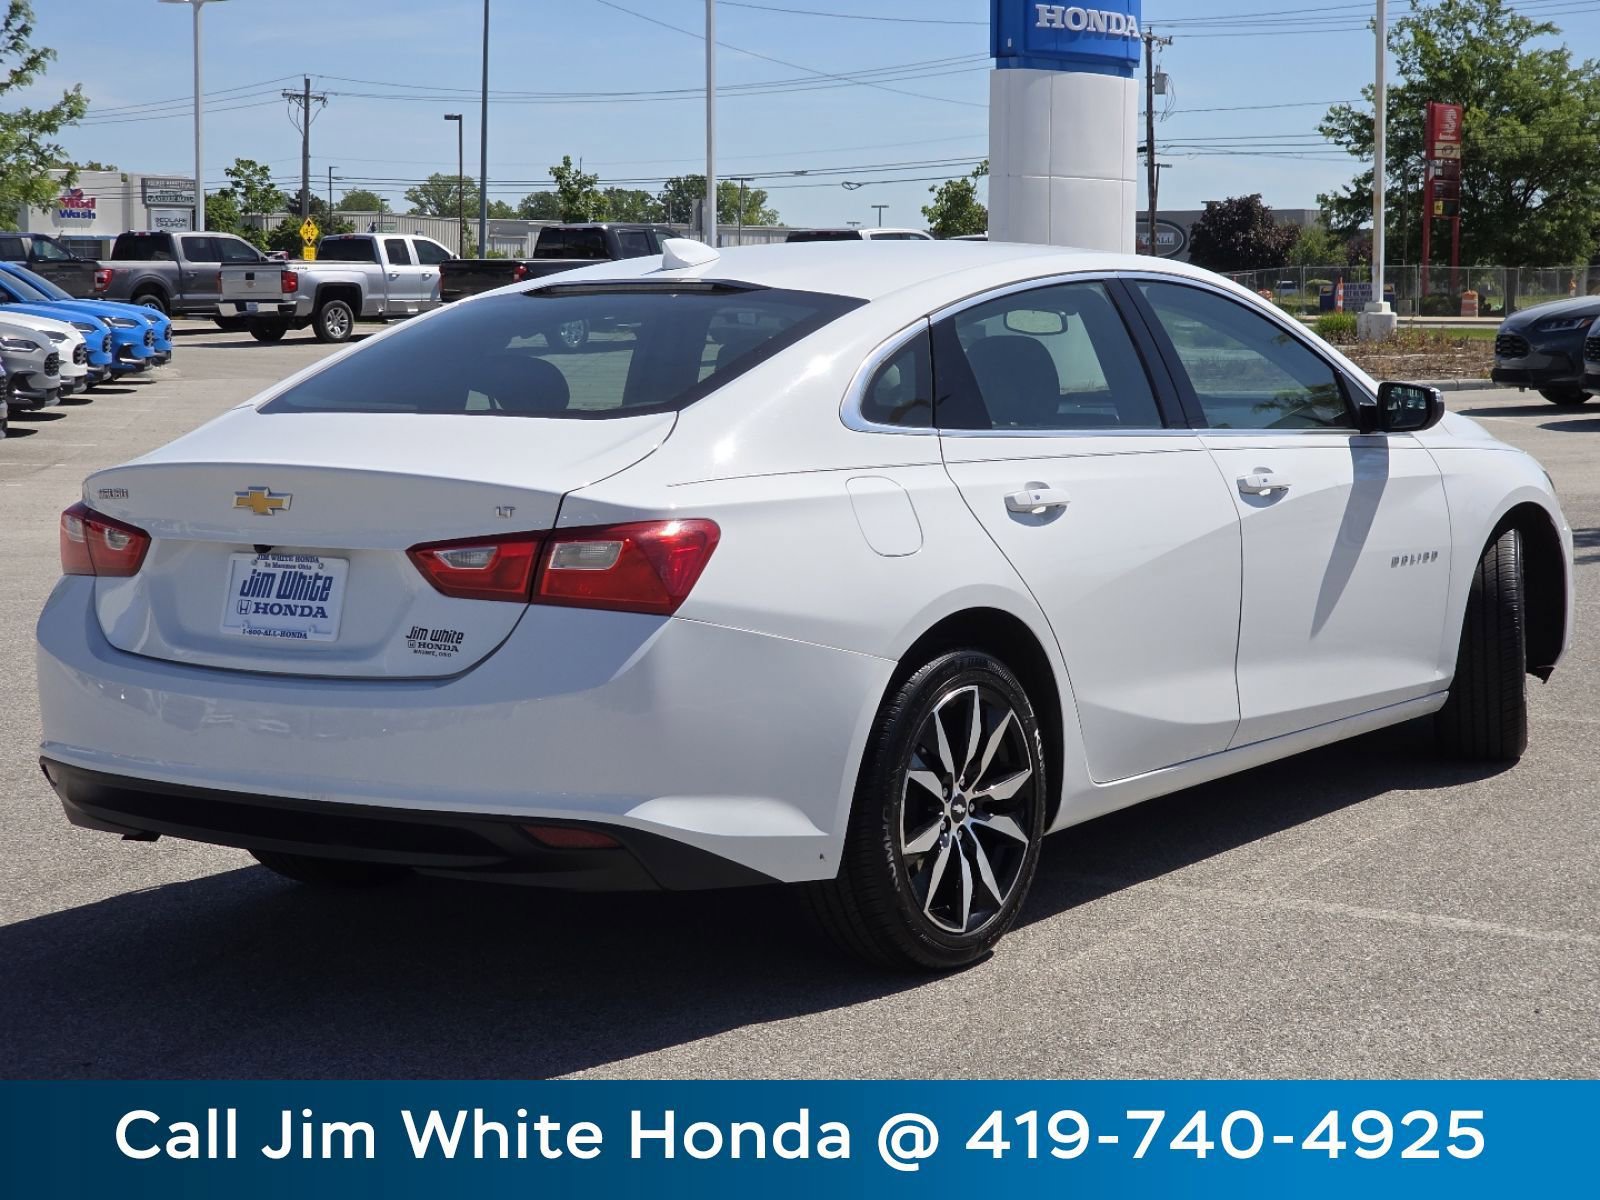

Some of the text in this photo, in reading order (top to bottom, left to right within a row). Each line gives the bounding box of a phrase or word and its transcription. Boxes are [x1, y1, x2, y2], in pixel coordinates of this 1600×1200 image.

[1035, 4, 1141, 38] HONDA
[59, 210, 96, 219] Wash
[496, 506, 516, 519] LT
[256, 553, 320, 564] JIM WHITE HONDA
[276, 571, 333, 602] White
[253, 602, 328, 619] HONDA
[242, 628, 308, 640] 1-800-ALL-HONDA
[430, 629, 464, 644] White
[417, 642, 459, 652] HONDA
